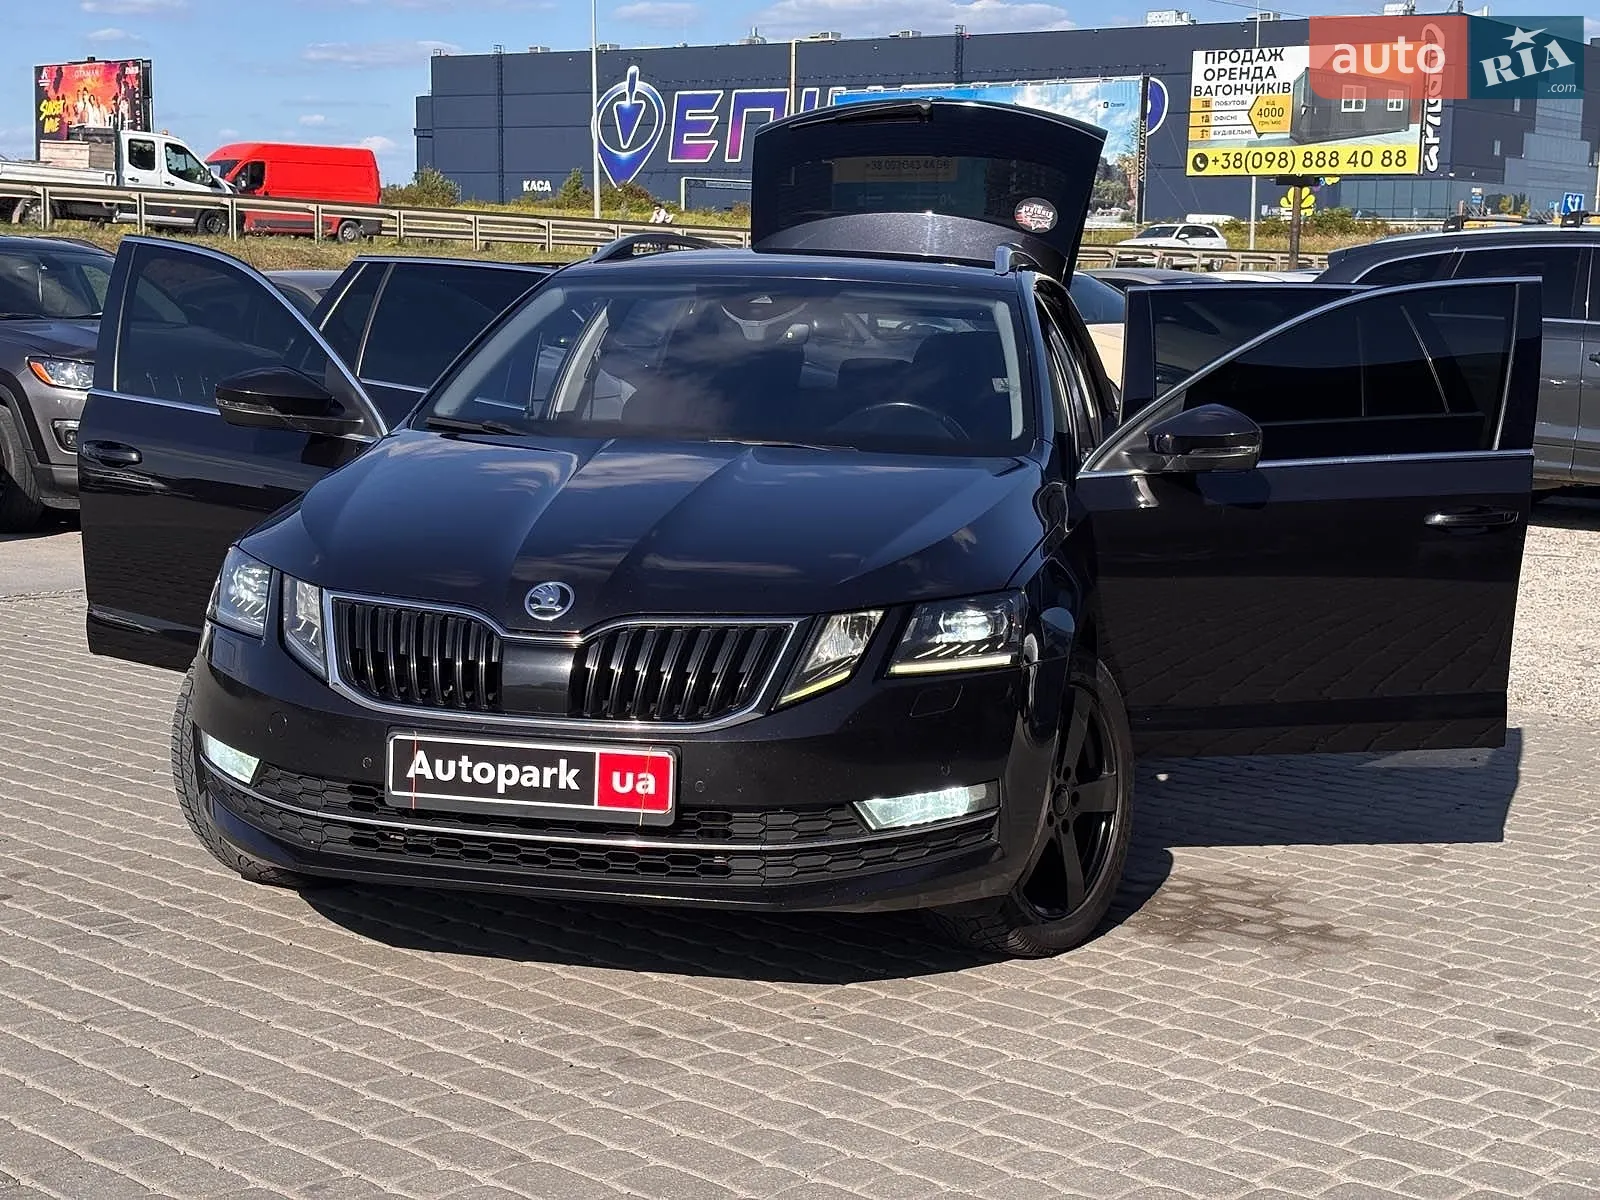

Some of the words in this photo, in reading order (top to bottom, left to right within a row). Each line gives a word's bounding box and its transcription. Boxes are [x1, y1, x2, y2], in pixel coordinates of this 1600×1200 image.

[1204, 48, 1285, 65] ПРОДАЖ
[1203, 66, 1277, 82] ОРЕНДА
[1193, 82, 1291, 97] ВАГОНЧИКІВ
[1256, 107, 1285, 118] 4000
[1211, 150, 1296, 173] +38(098)
[1302, 150, 1339, 168] 888
[1346, 150, 1373, 167] 40
[1380, 150, 1407, 167] 88
[523, 180, 552, 192] КАСА
[406, 750, 580, 793] Autopark
[611, 770, 656, 795] ua
